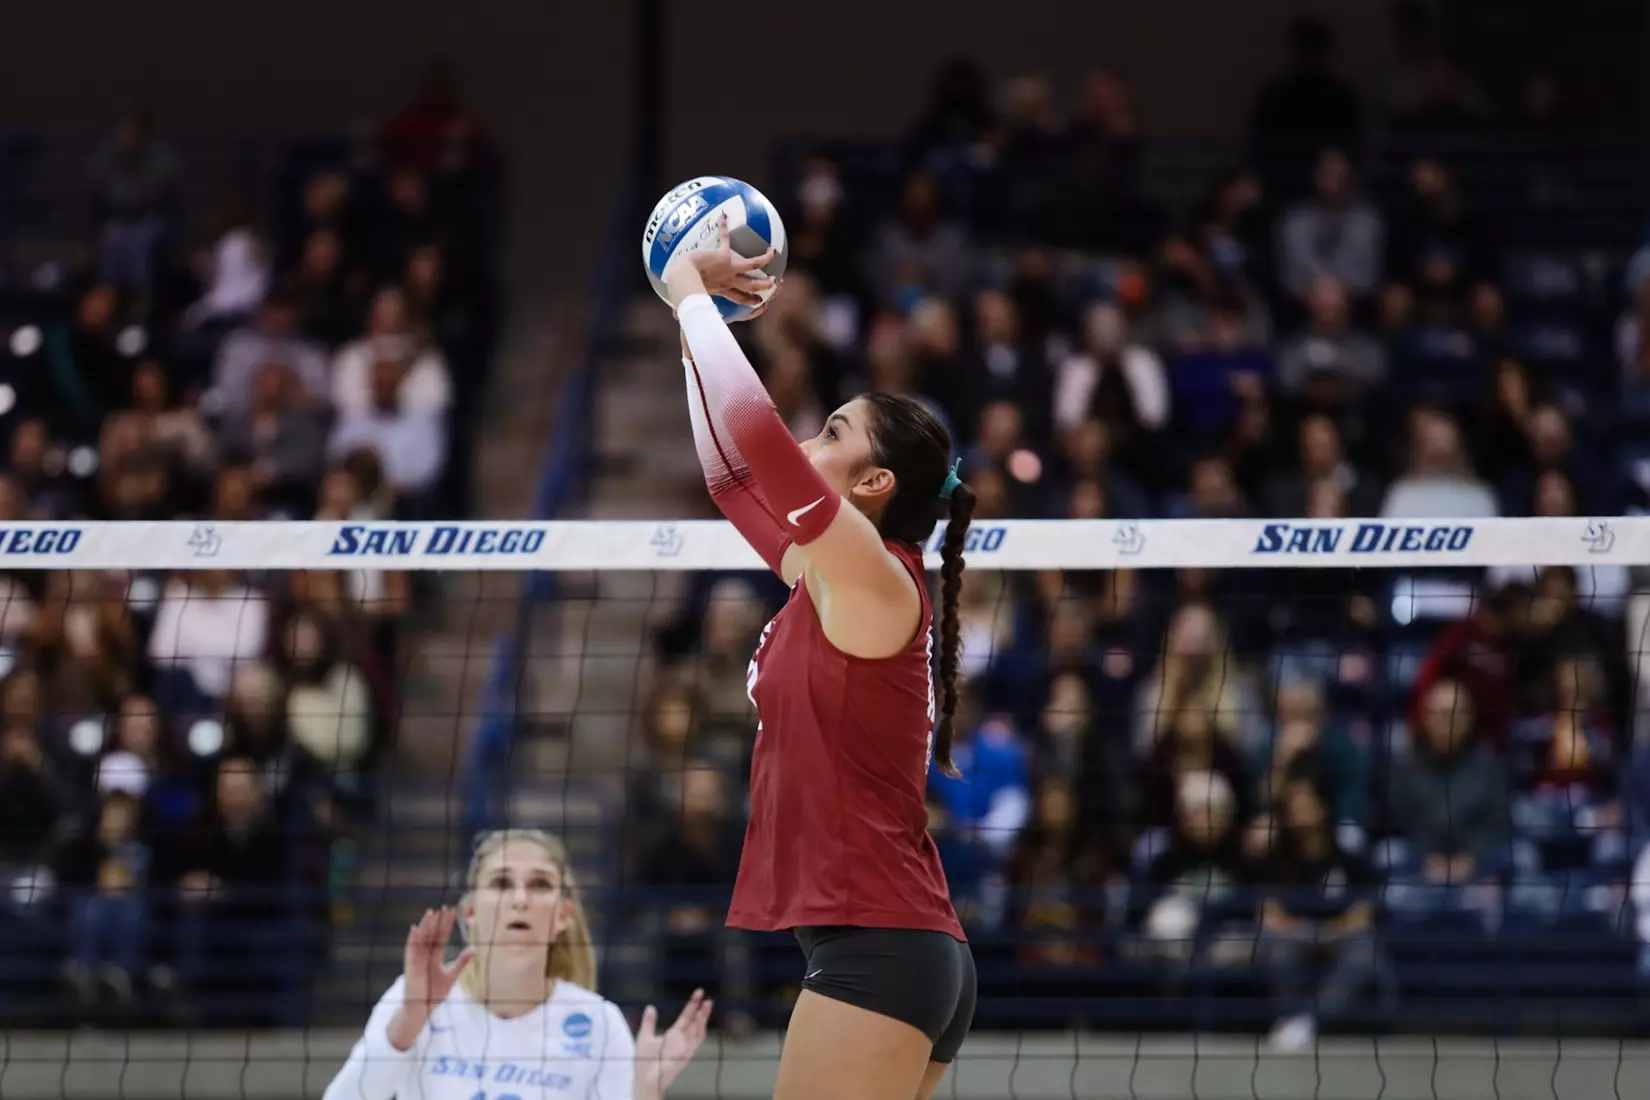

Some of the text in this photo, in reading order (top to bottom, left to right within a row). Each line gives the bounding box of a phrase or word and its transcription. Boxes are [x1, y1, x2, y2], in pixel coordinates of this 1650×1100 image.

[646, 181, 702, 243] moten
[657, 192, 709, 252] NCAA
[327, 526, 548, 555] SAN DIEGO
[1252, 524, 1475, 552] SAN DIEGO
